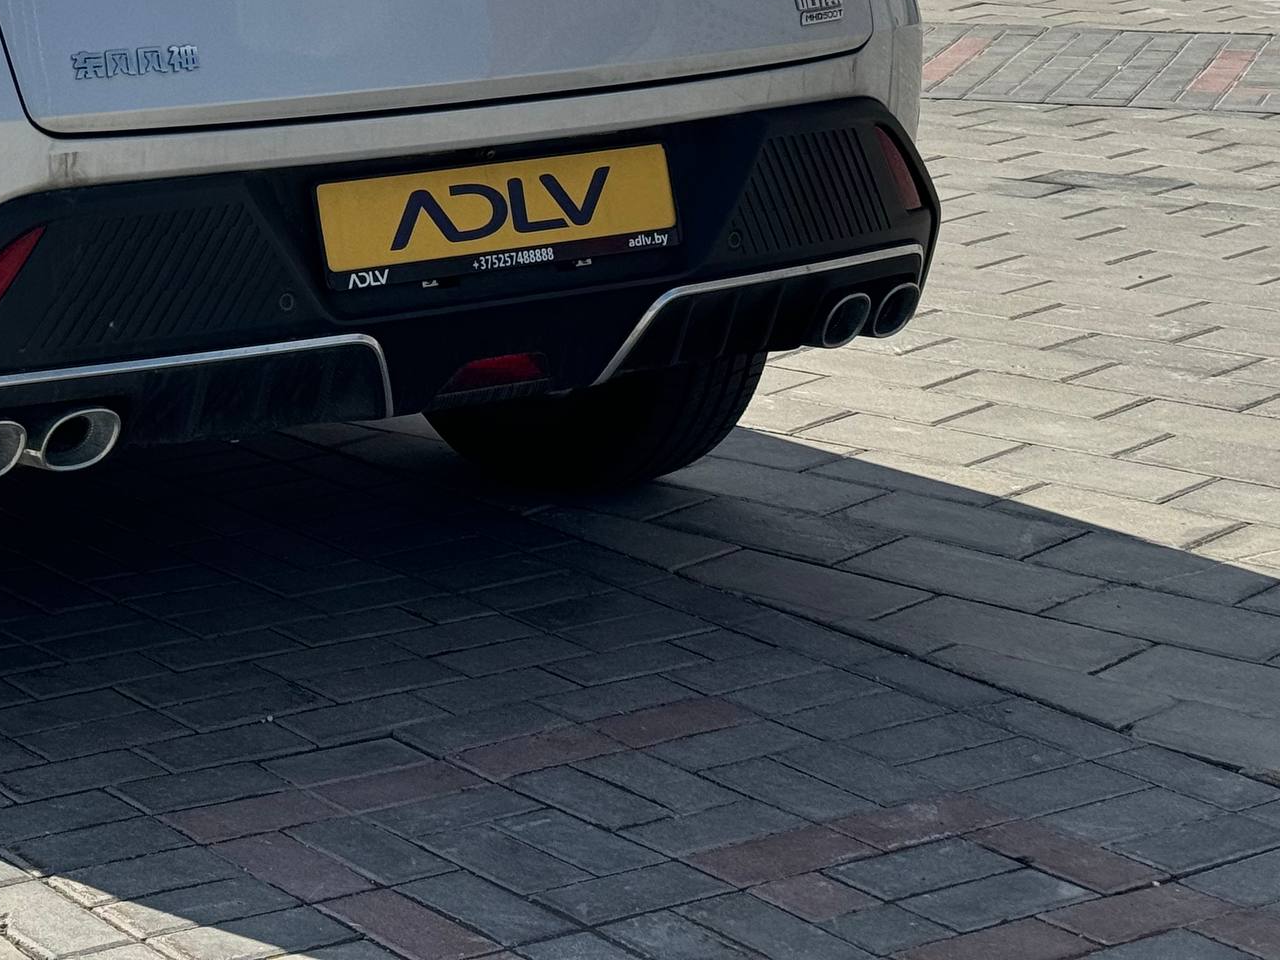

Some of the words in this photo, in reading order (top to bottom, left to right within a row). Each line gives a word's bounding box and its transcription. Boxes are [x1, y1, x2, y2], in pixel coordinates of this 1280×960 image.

[71, 43, 201, 80] 东风风神
[389, 165, 611, 252] ADLV
[628, 231, 669, 248] adlv.by
[472, 247, 555, 271] +375257488888
[348, 268, 390, 290] ADLV
